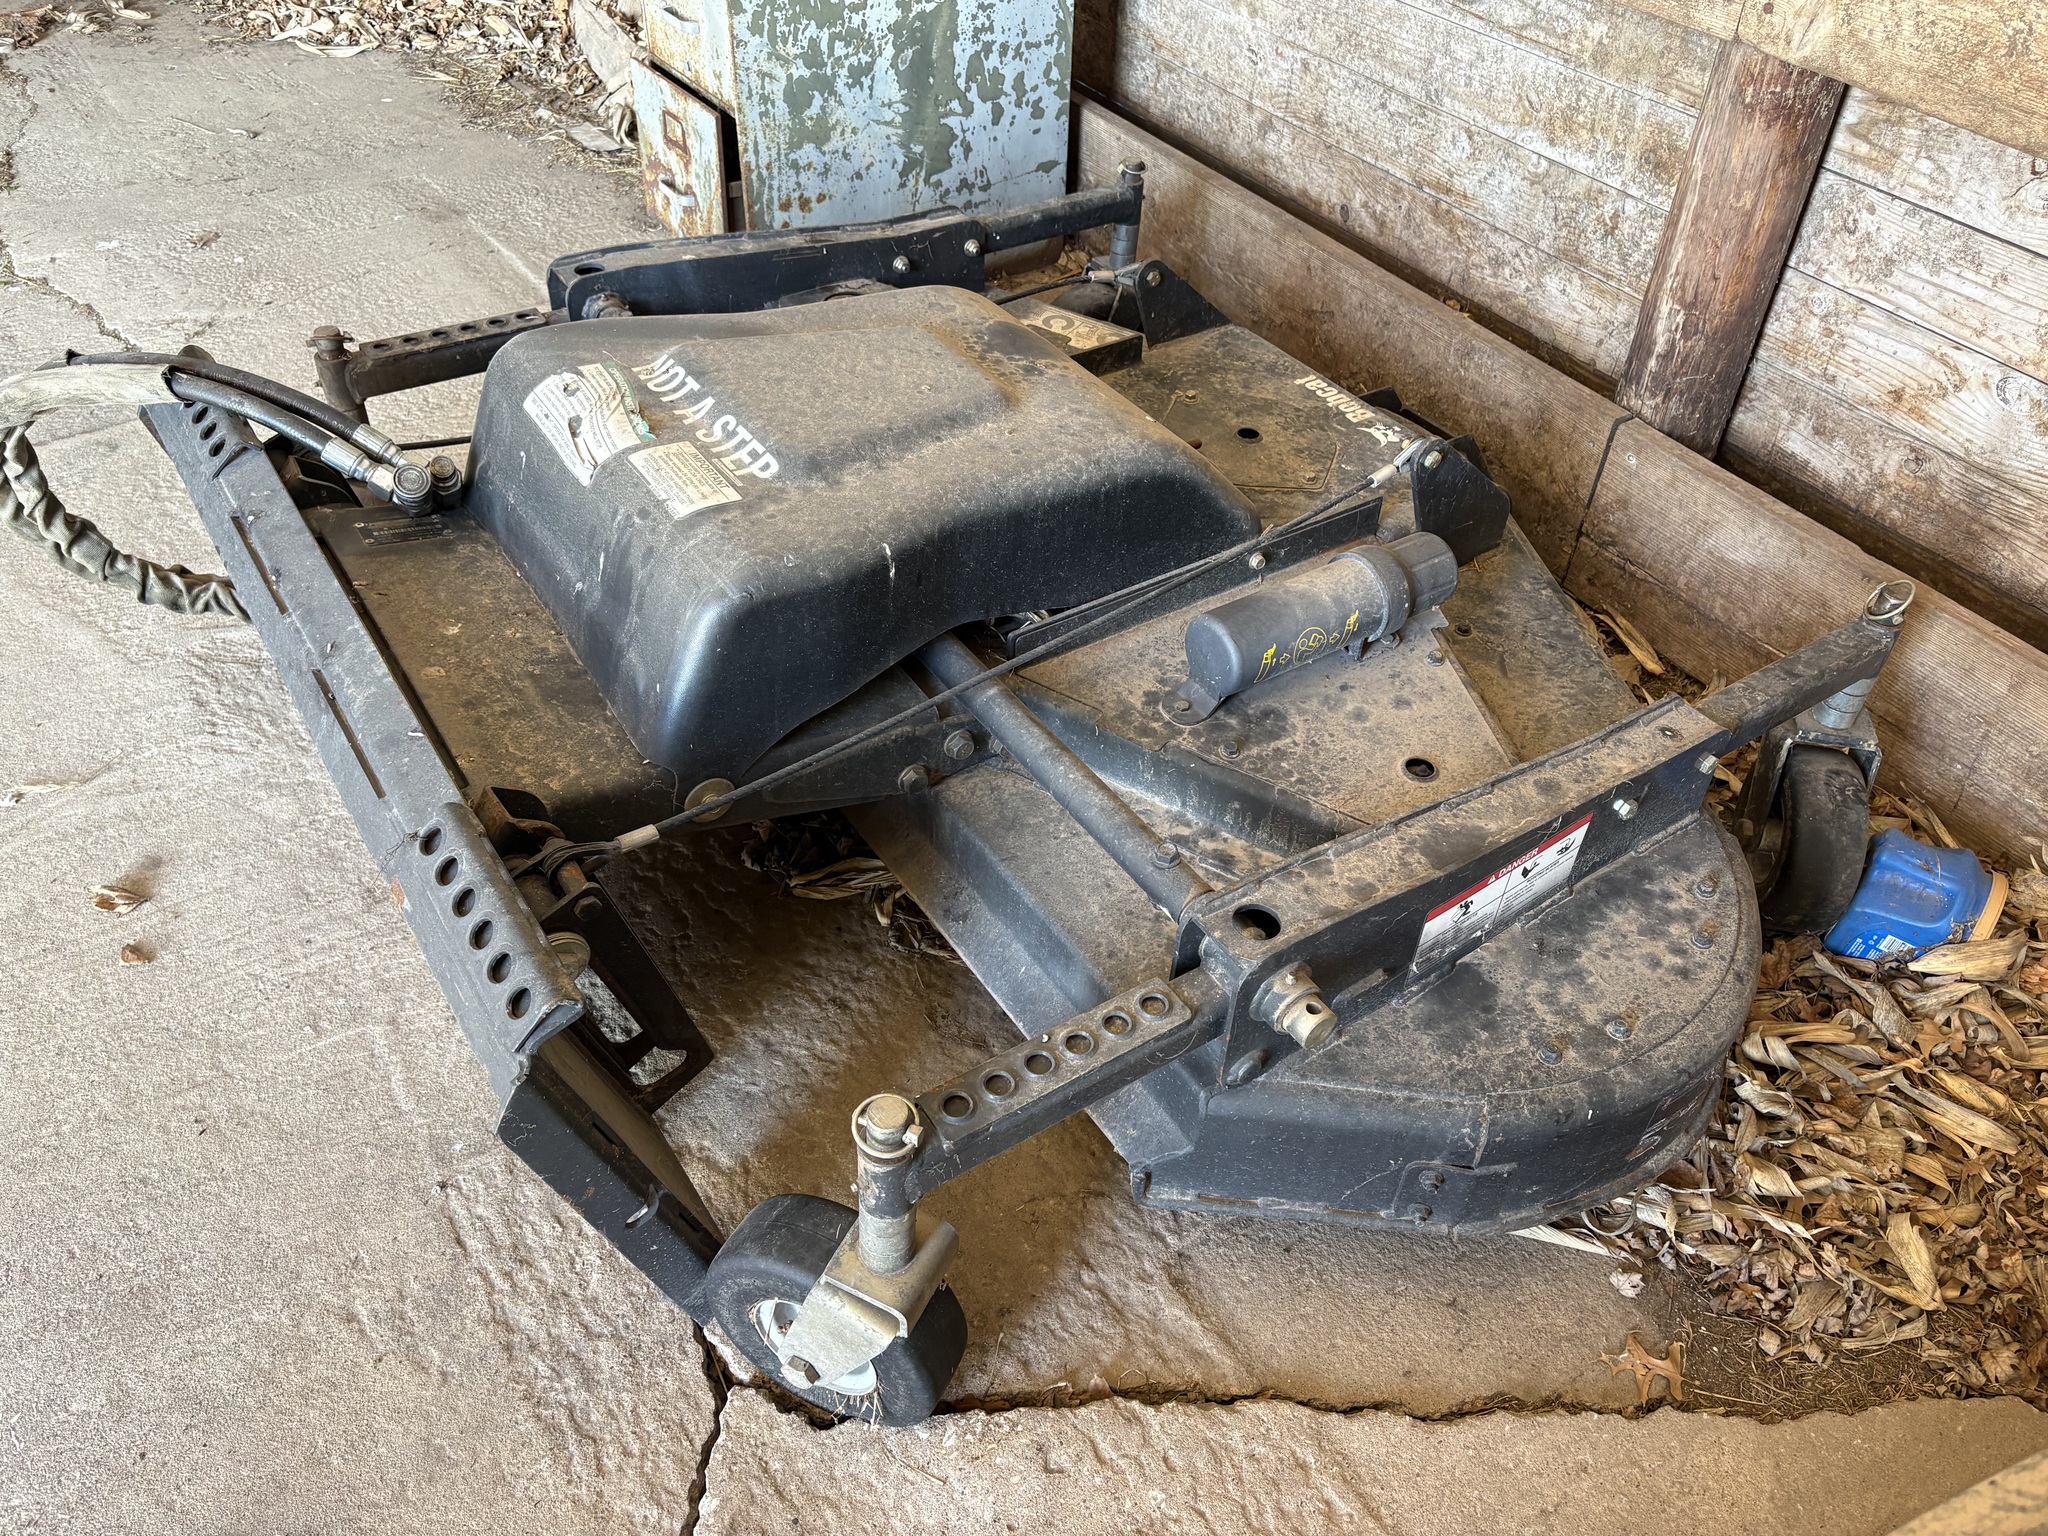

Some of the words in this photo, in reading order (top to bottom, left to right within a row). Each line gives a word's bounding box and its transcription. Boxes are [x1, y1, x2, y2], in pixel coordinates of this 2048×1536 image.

[632, 354, 702, 402] NOT
[674, 396, 715, 425] A
[696, 415, 779, 479] STEP
[1294, 375, 1376, 423] Bobcat
[688, 450, 730, 491] IMPORTANT
[1498, 848, 1539, 878] DANGER
